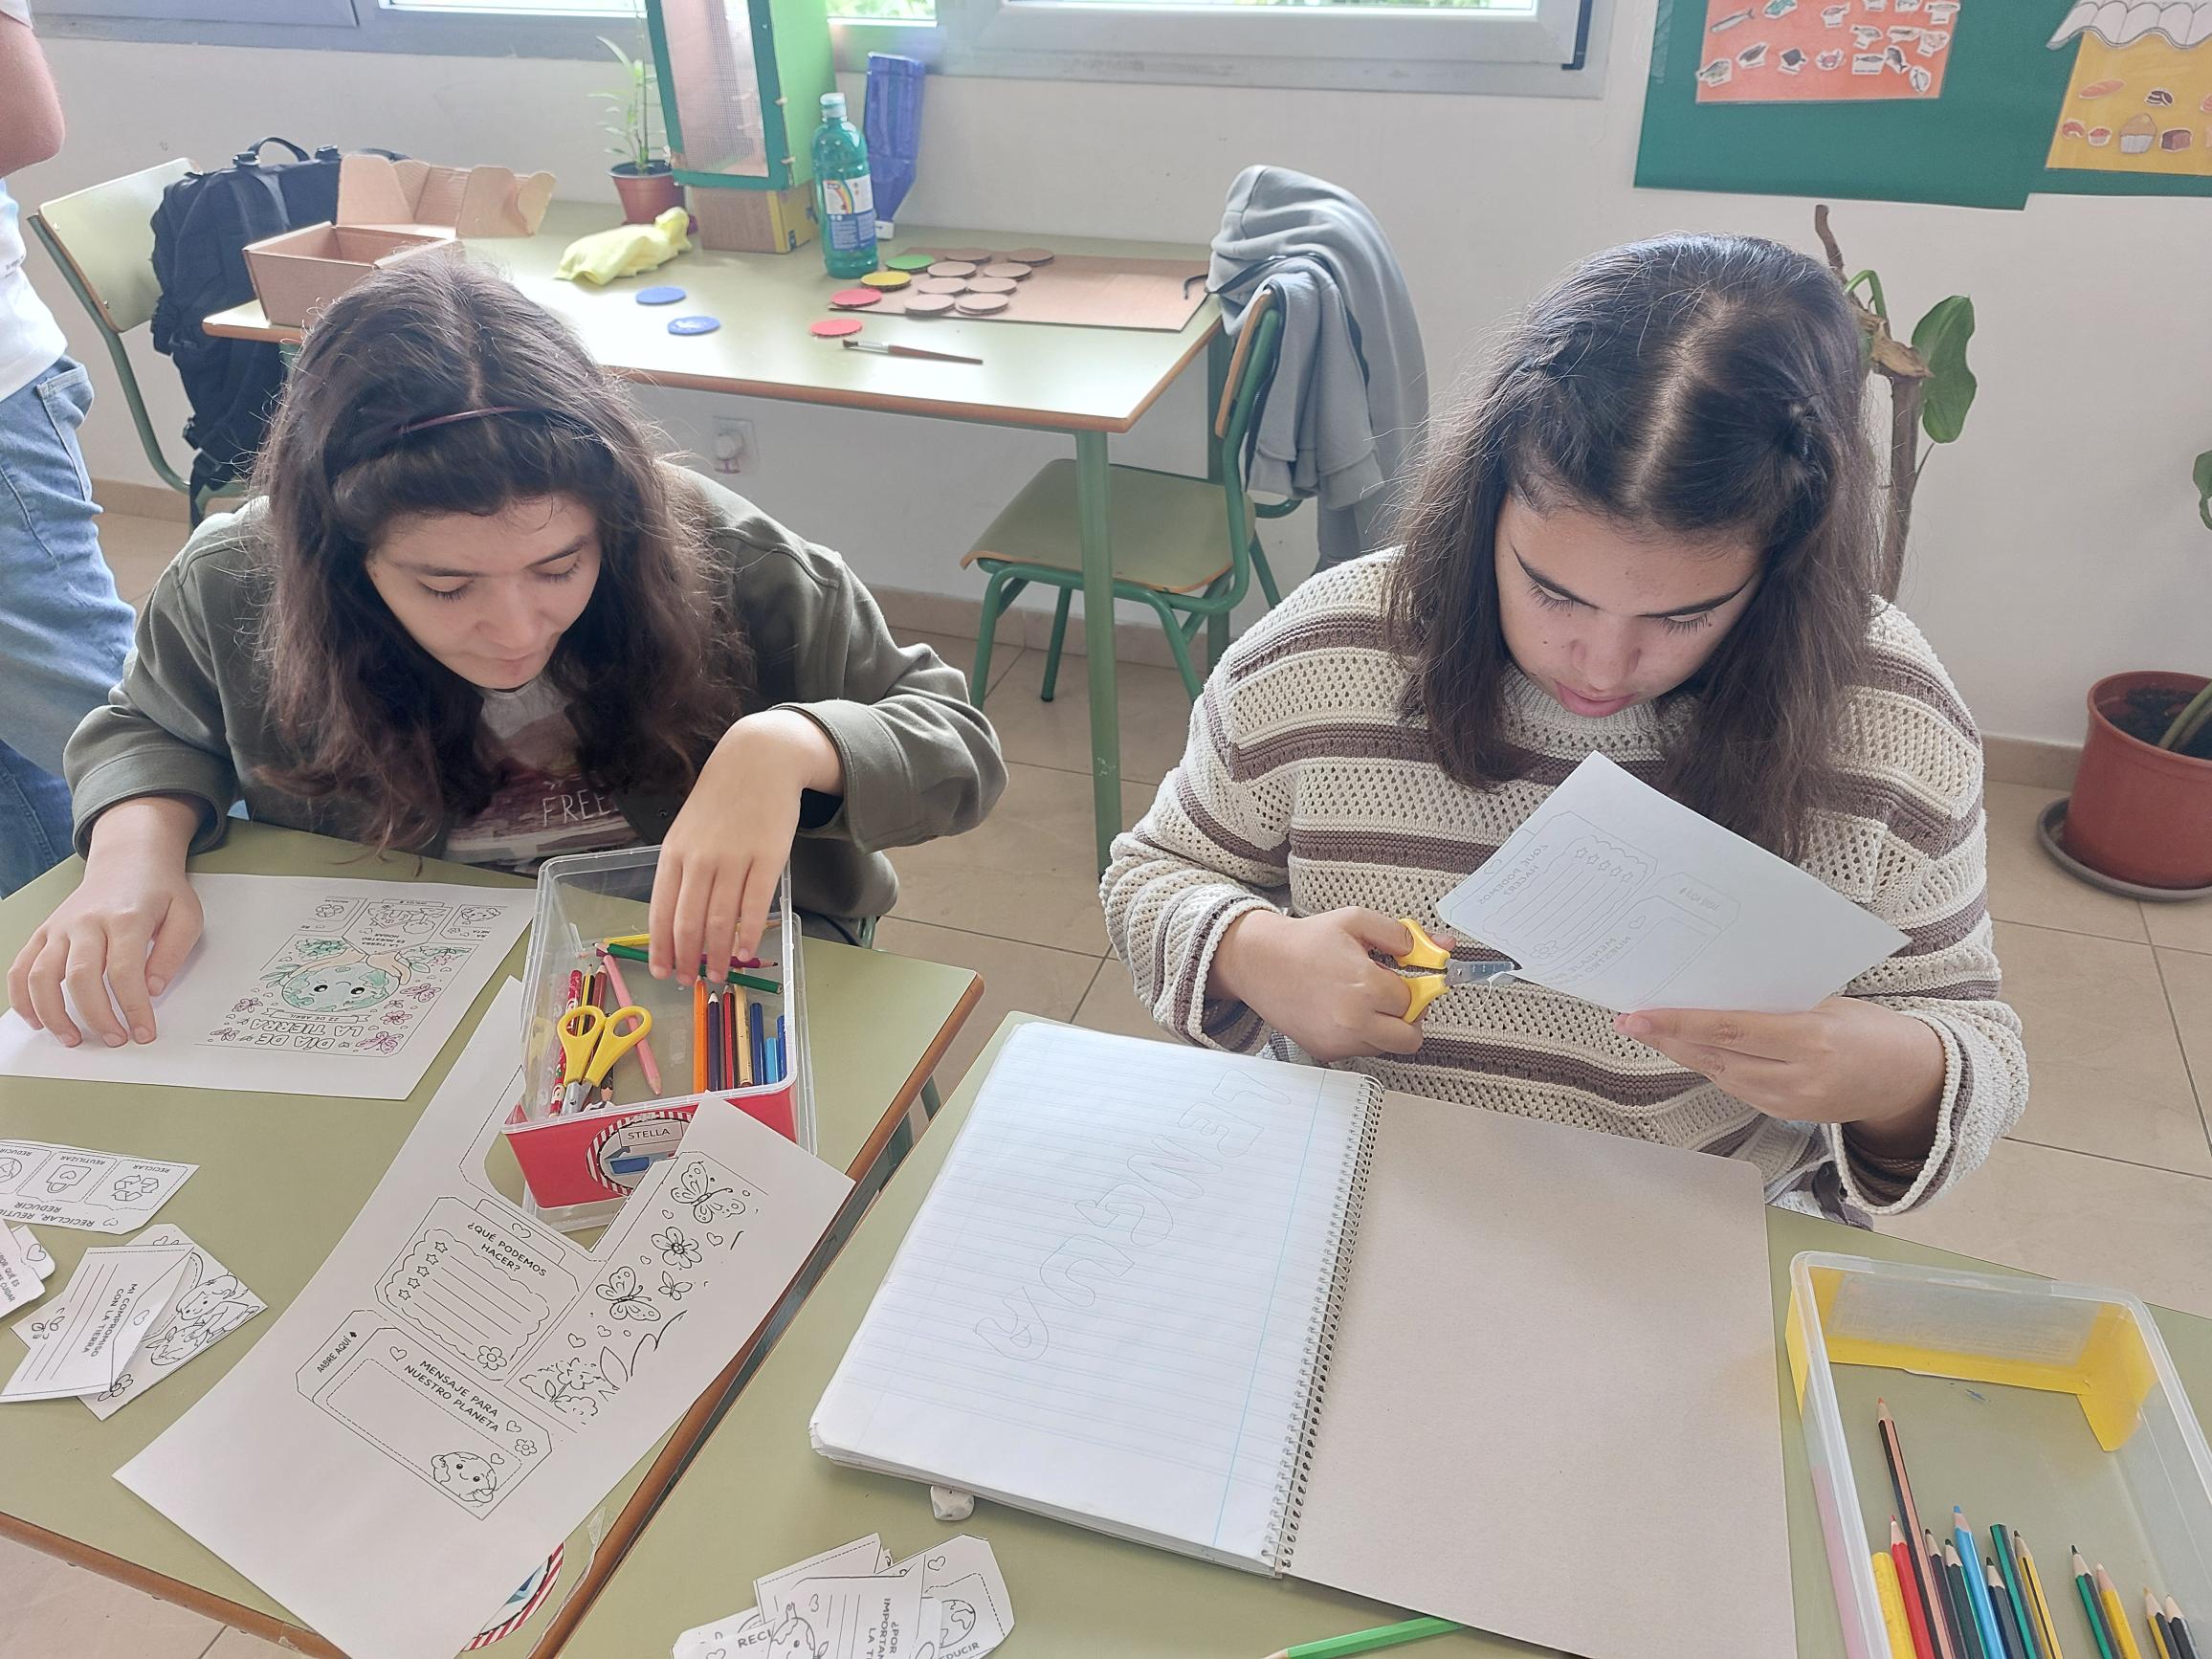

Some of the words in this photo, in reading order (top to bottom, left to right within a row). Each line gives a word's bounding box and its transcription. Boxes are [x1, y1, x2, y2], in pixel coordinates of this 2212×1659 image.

[543, 789, 618, 828] FREE
[250, 1019, 325, 1036] TIERRA
[334, 1026, 364, 1037] LA
[254, 1033, 290, 1047] DE
[294, 1035, 336, 1051] DÍA
[628, 1128, 671, 1140] STELLA
[60, 1155, 105, 1165] REUTILIZAR
[133, 1163, 171, 1174] RECICLAR
[14, 1202, 62, 1213] REDUCIR
[973, 1070, 1291, 1361] LENGUA
[40, 1211, 95, 1228] RECICLAR,
[467, 1222, 498, 1243] ¿QUÉ
[498, 1240, 547, 1276] PODEMOS
[481, 1243, 521, 1272] HACER?
[110, 1288, 124, 1307] CON
[127, 1283, 138, 1294] MI
[102, 1311, 114, 1321] LA
[91, 1297, 130, 1357] COMPROMISO
[82, 1323, 106, 1354] TIERRA
[335, 1335, 351, 1355] AQUÍ
[419, 1360, 470, 1397] MENSAJE
[471, 1395, 498, 1417] PARA
[404, 1364, 453, 1400] NUESTRO
[453, 1399, 498, 1432] PLANETA
[738, 1629, 771, 1648] RECI
[868, 1627, 876, 1644] LA
[890, 1621, 899, 1654] ¿POR
